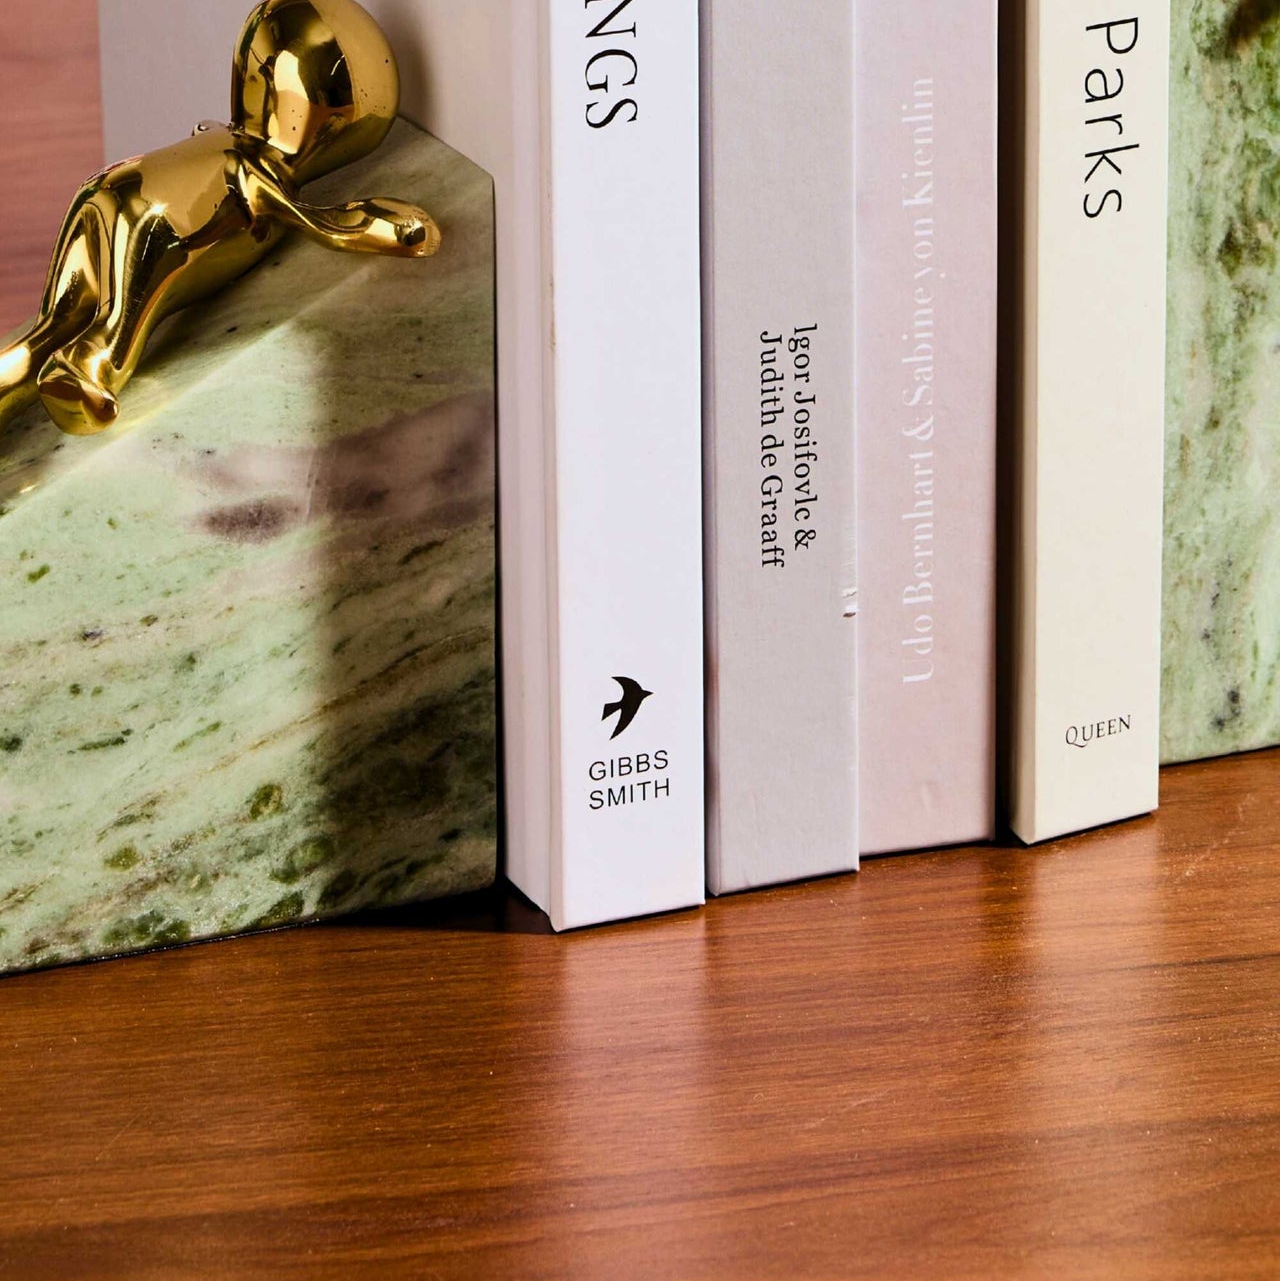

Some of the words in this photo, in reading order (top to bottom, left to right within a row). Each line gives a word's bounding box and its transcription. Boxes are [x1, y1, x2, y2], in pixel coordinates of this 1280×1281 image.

[901, 76, 934, 208] Kienlin
[1084, 17, 1139, 218] Parks
[760, 330, 785, 428] Judith
[901, 286, 934, 408] Sabine
[761, 435, 784, 468] de
[901, 414, 934, 441] &
[761, 475, 784, 568] Graaff
[794, 529, 816, 550] &
[901, 450, 934, 606] Bernhart
[901, 614, 934, 684] Udo
[588, 749, 669, 781] GIBBS
[1065, 714, 1131, 748] QUEEN
[589, 777, 670, 810] SMITH
